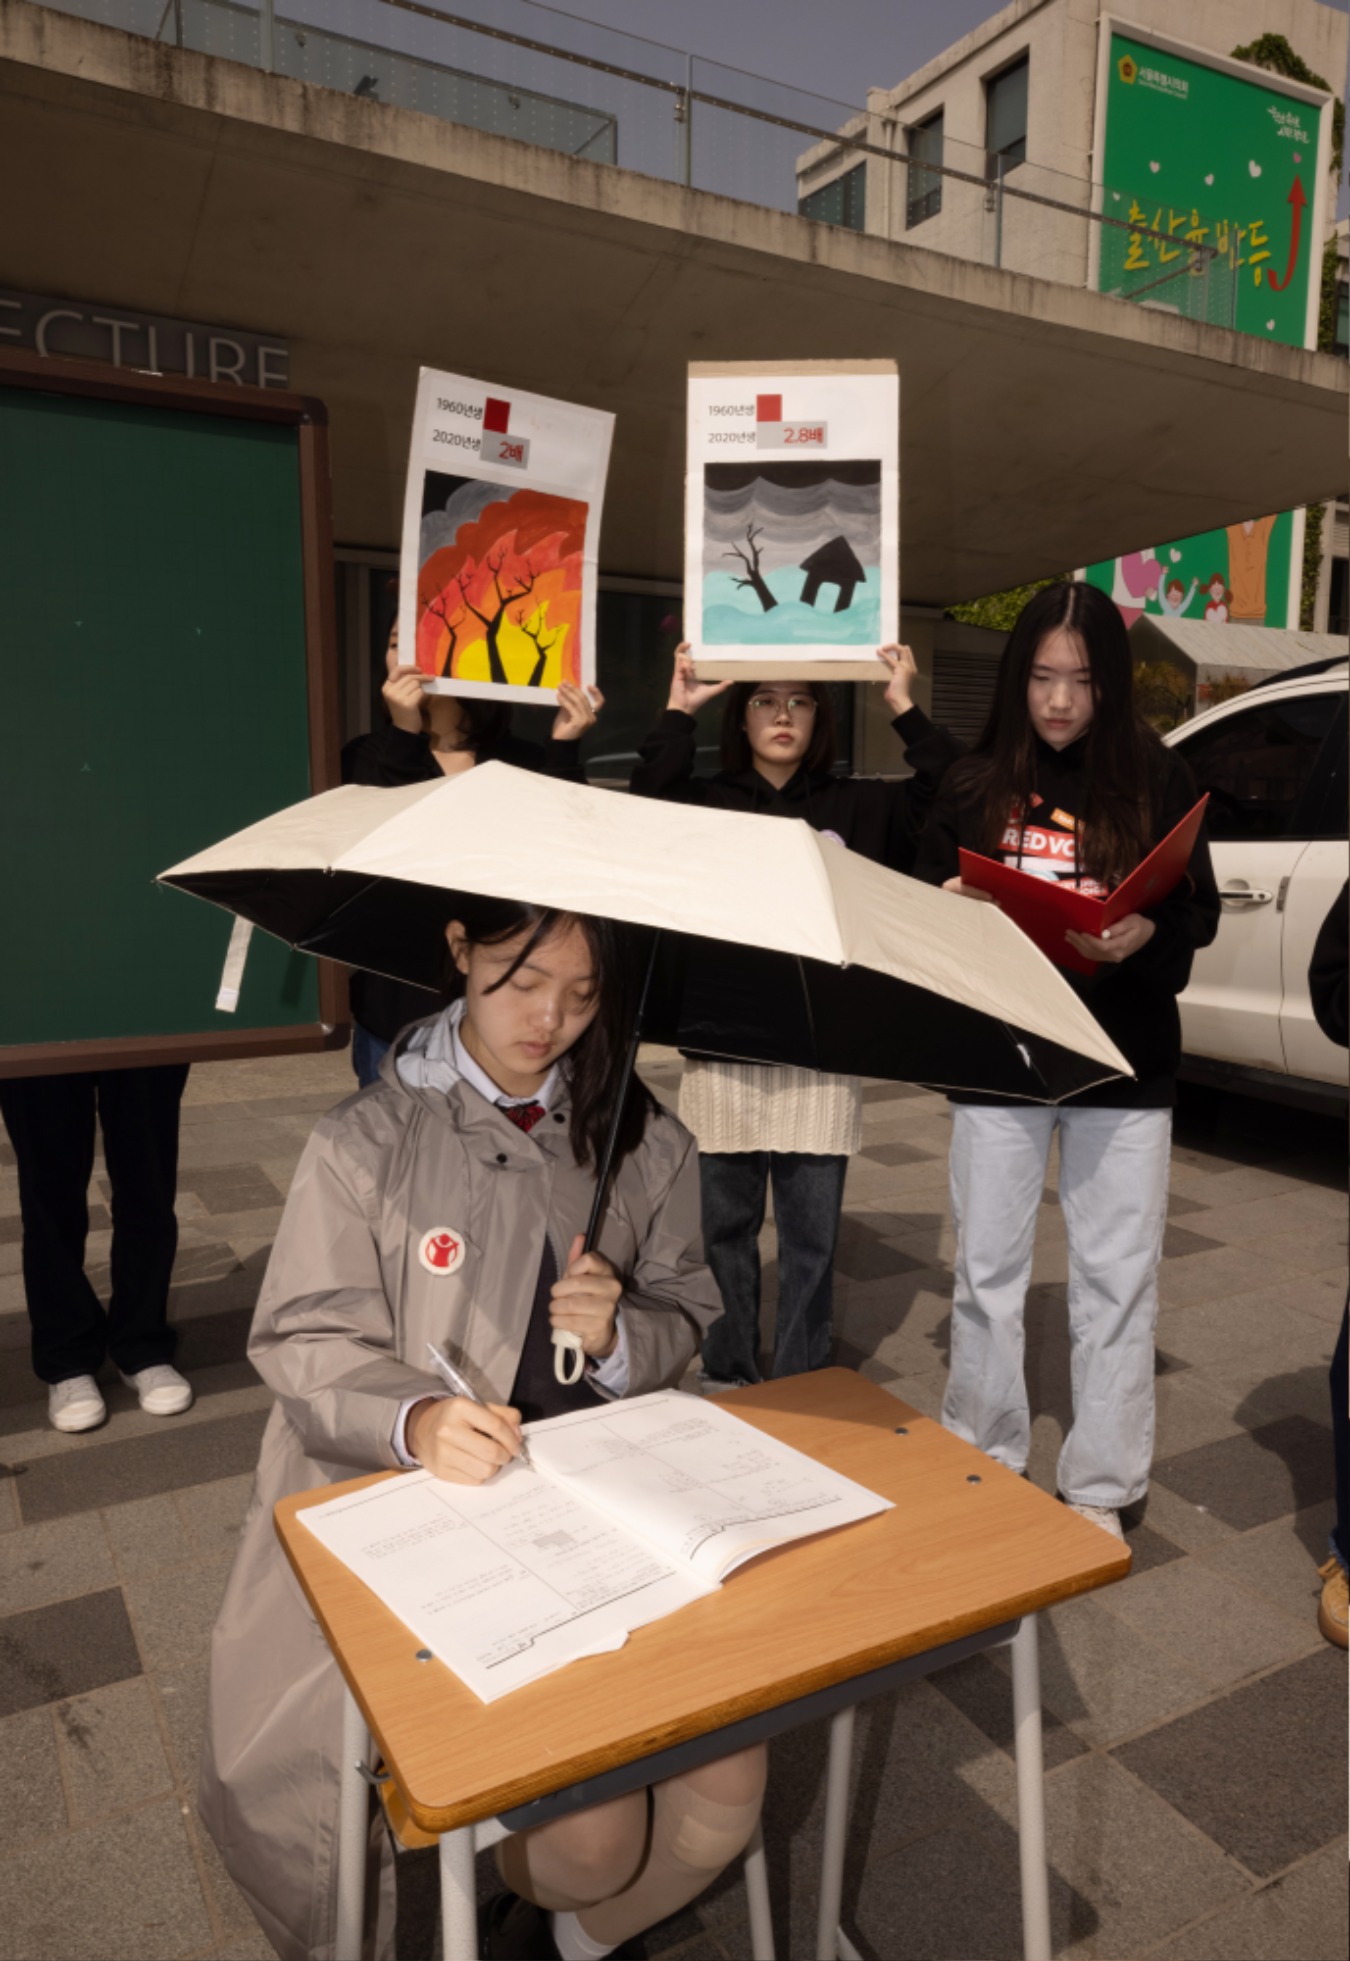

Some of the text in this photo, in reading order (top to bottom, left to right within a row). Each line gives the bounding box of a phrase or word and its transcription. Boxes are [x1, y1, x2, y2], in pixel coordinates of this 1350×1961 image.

[1124, 199, 1209, 276] 출산율
[437, 397, 483, 421] 1960년생
[708, 404, 755, 417] 1960년생
[432, 429, 524, 463] 2020년생 2배
[708, 426, 824, 444] 2020년생 2.8배
[1002, 828, 1047, 851] RED
